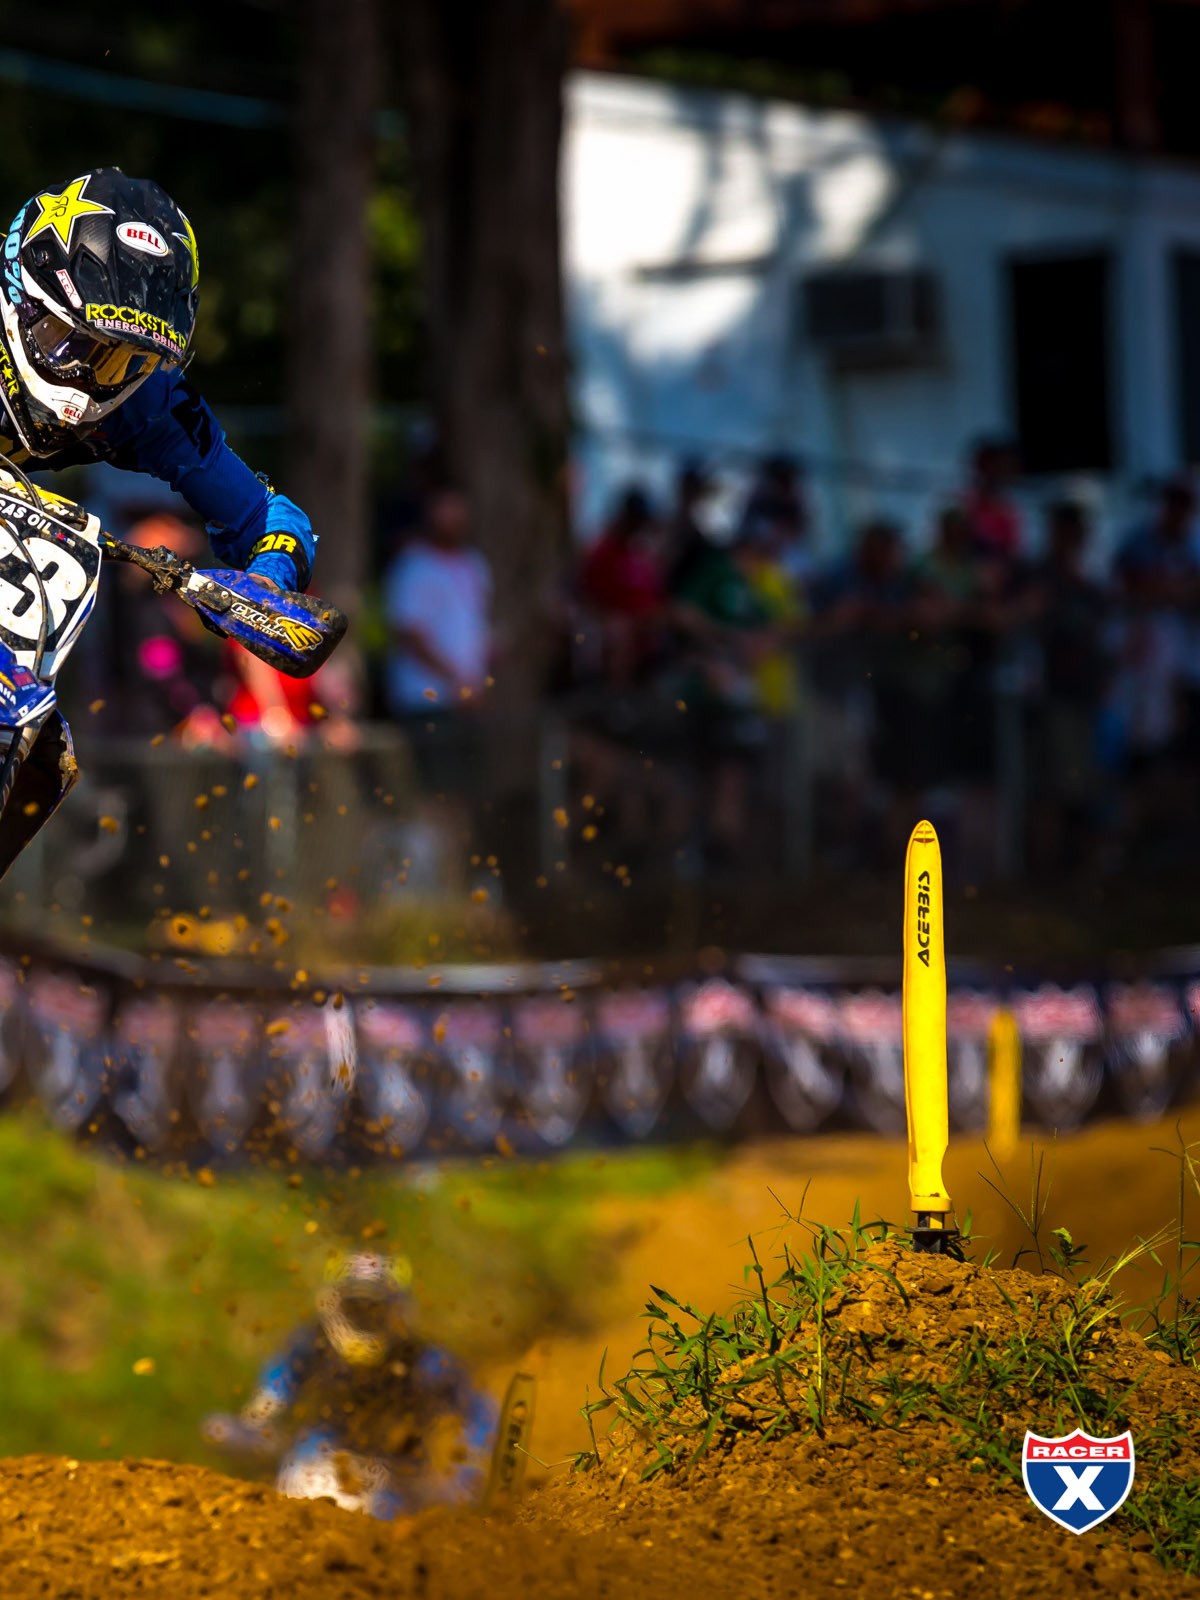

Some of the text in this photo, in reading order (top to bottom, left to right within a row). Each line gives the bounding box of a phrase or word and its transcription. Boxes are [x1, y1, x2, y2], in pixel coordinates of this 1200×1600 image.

[126, 227, 162, 250] BELL
[96, 318, 183, 354] ENERGY DRINK
[63, 407, 81, 420] BELL
[27, 513, 53, 535] OIL
